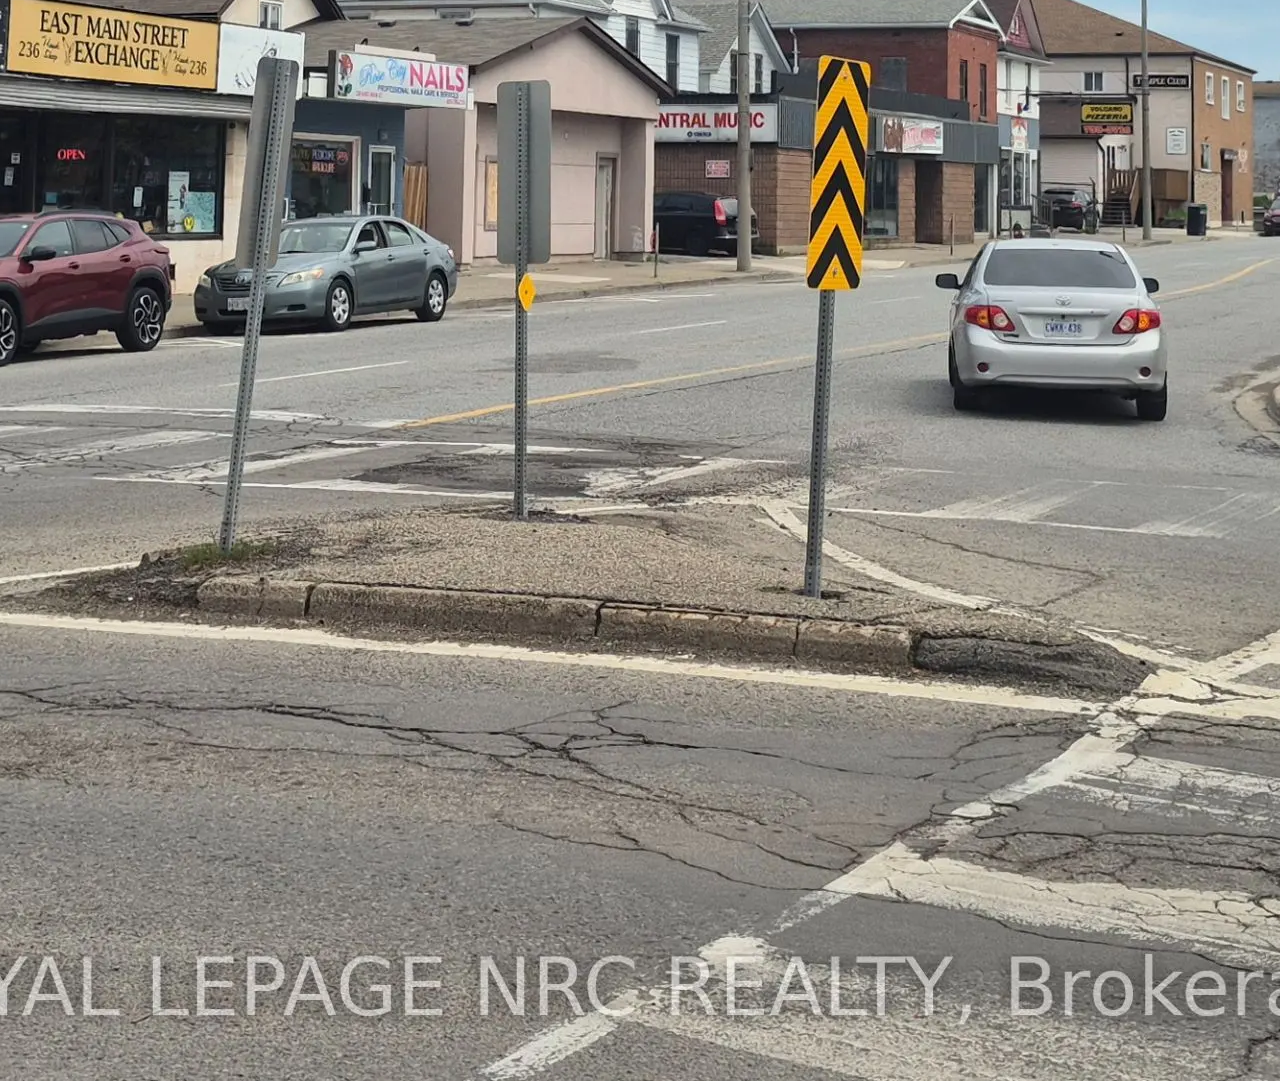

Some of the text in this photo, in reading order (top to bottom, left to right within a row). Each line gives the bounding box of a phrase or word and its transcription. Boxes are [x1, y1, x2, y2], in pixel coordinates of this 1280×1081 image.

[39, 9, 189, 49] EAST MAIN STREET
[18, 40, 40, 59] 236
[74, 40, 160, 72] EXCHANGE
[189, 60, 207, 76] 236
[409, 61, 465, 93] NAILS
[1136, 76, 1166, 84] TMPLE
[377, 84, 409, 96] PROFESSIONAL
[654, 111, 765, 129] NTRAL MUIC
[1085, 113, 1129, 121] PIZZERIA
[57, 148, 87, 161] OPEN
